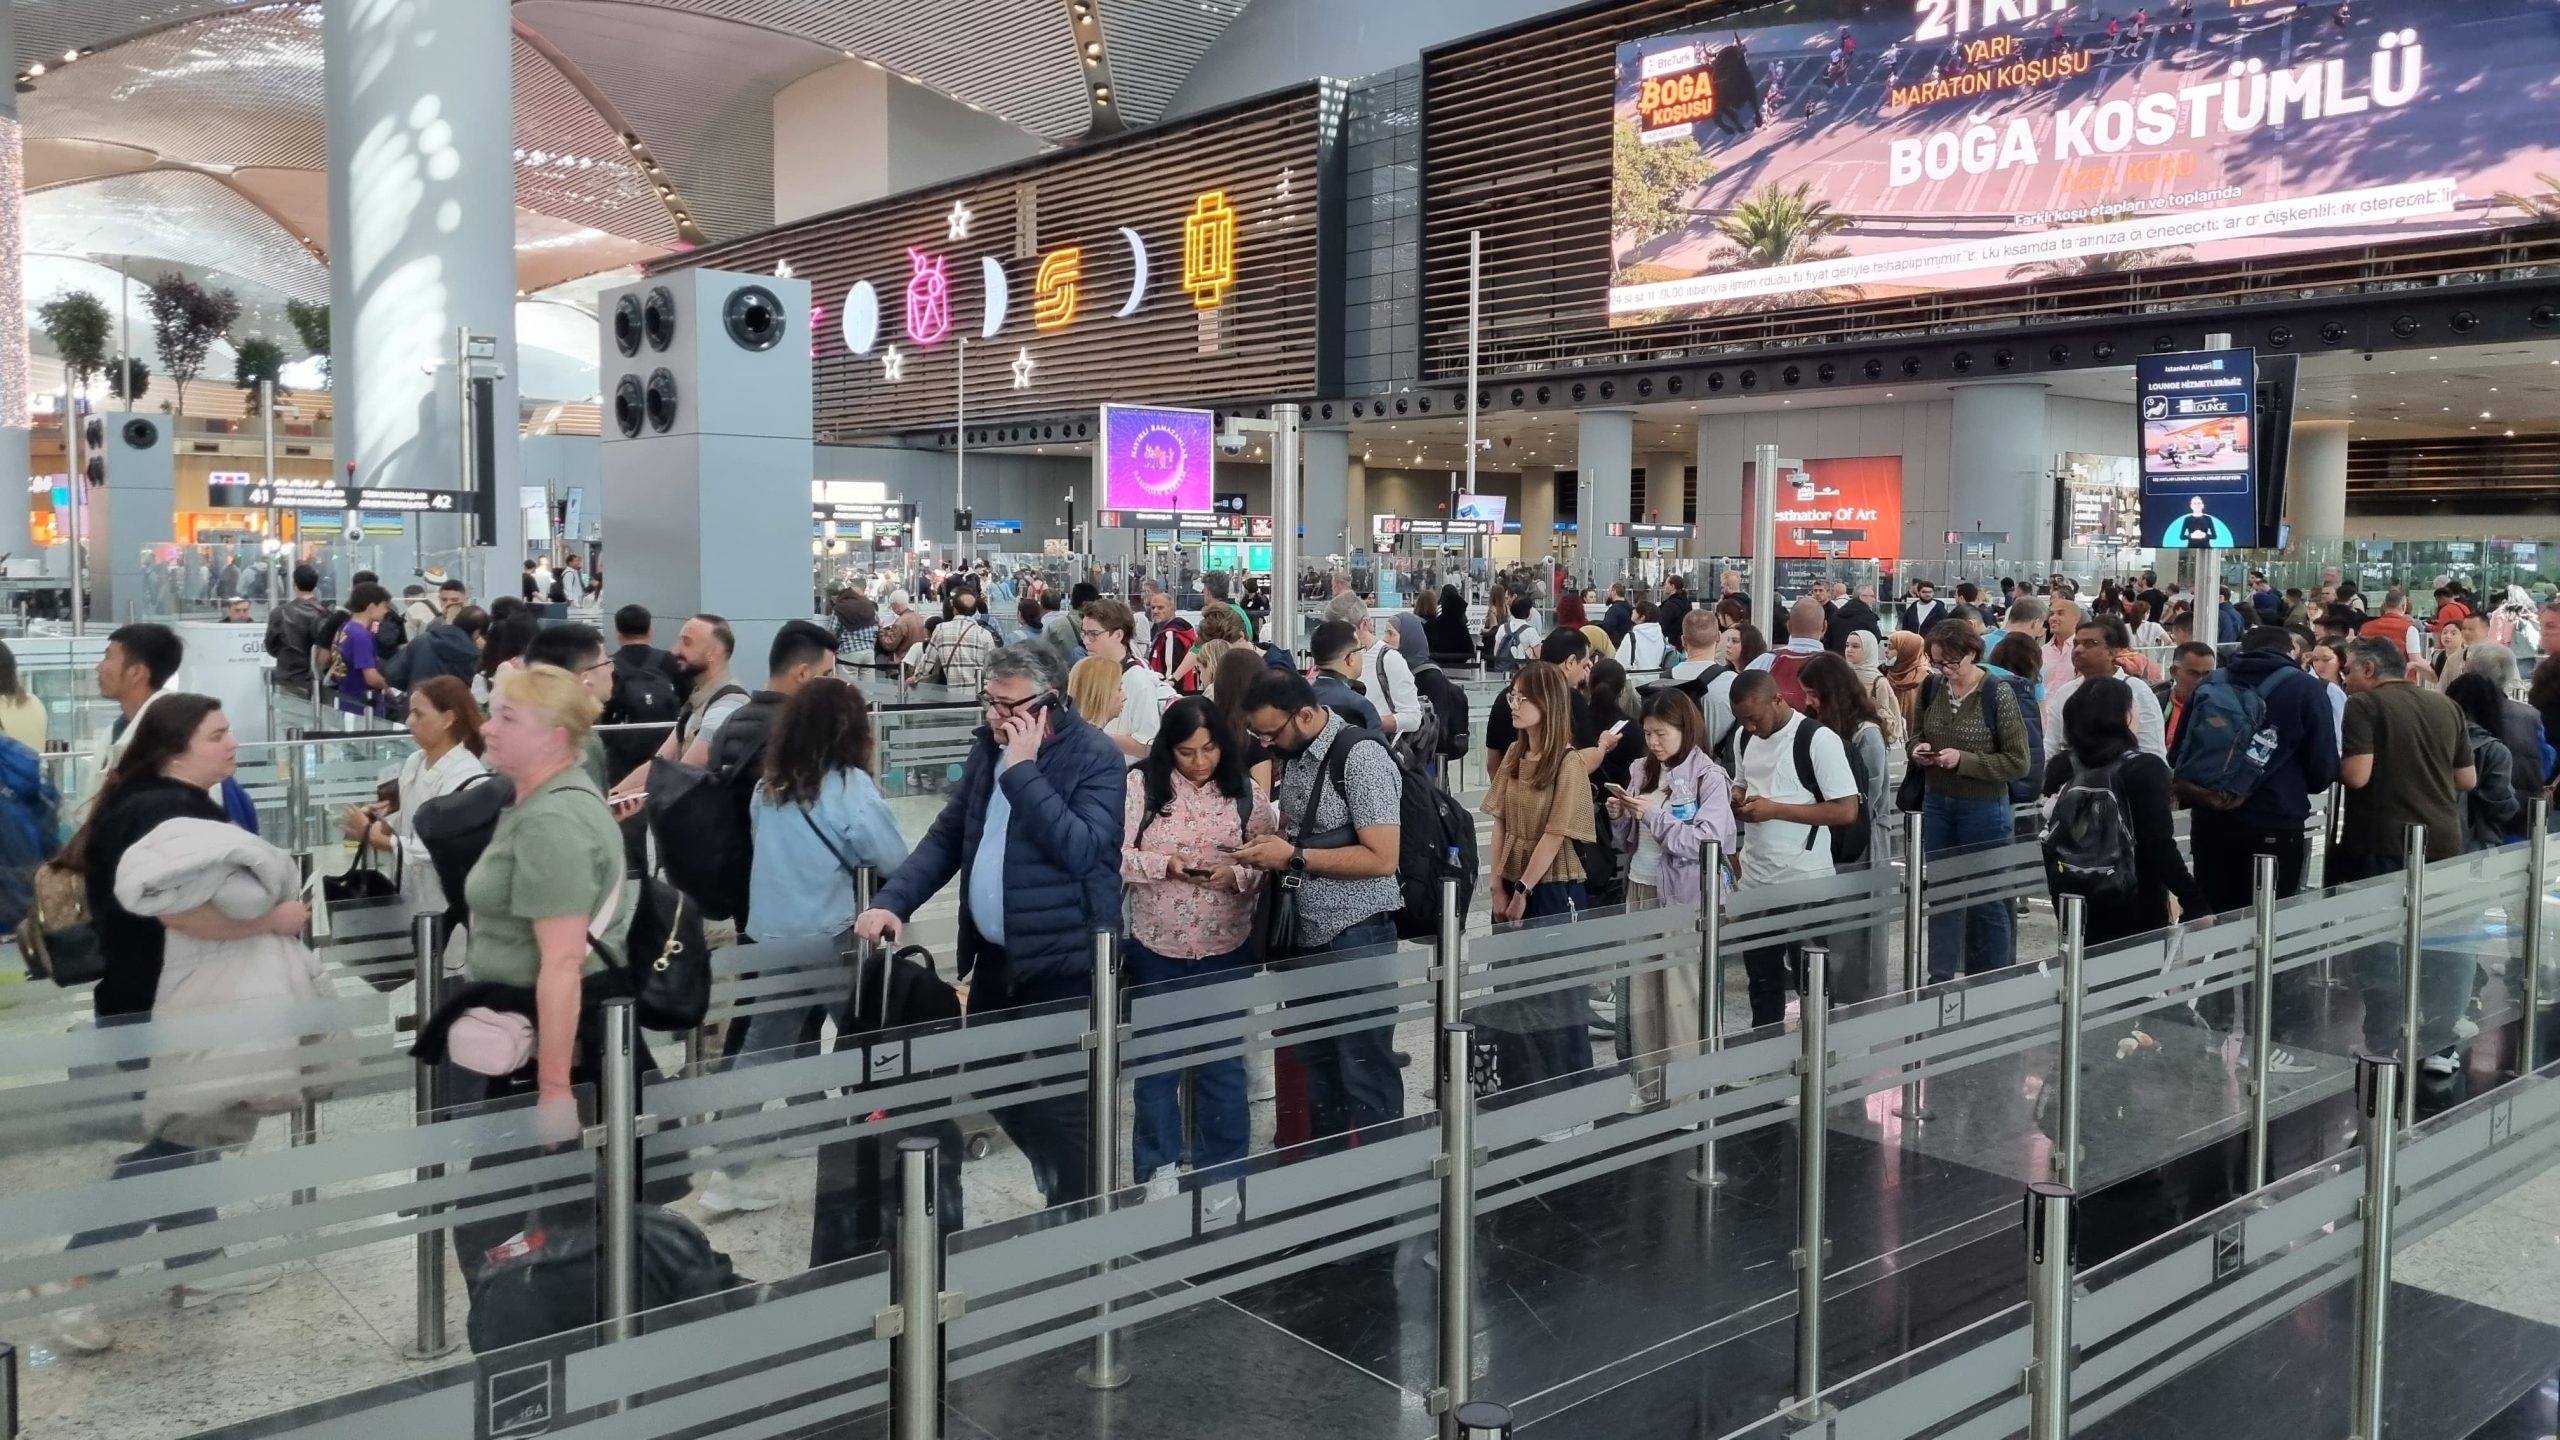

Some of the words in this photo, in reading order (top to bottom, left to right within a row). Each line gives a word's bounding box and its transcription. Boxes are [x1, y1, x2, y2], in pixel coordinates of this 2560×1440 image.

[1964, 34, 2012, 64] YARI
[1657, 52, 1691, 69] BtcTurk
[1891, 68, 1991, 108] MARATON
[1997, 50, 2091, 88] KOŞUSU
[1652, 97, 1712, 126] KOŞUSU
[1889, 113, 2038, 188] BOĞA
[2054, 28, 2422, 160] KOSTÜMLÜ
[2060, 165, 2119, 193] ÖZEL
[2127, 153, 2196, 183] KOŞU
[2054, 207, 2088, 222] koşu
[2090, 201, 2146, 218] etapları
[2149, 196, 2166, 209] ve
[2169, 185, 2242, 208] toplamda
[2148, 382, 2180, 391] LOUNGE
[2194, 402, 2228, 412] LOUNGE
[249, 488, 270, 504] 41
[431, 494, 452, 509] 42
[885, 507, 899, 519] 44
[1774, 508, 1832, 522] estination
[1836, 508, 1854, 521] Of
[1855, 508, 1877, 521] Art
[1219, 516, 1230, 528] 46
[1400, 521, 1411, 532] 47
[242, 640, 267, 654] GÜL
